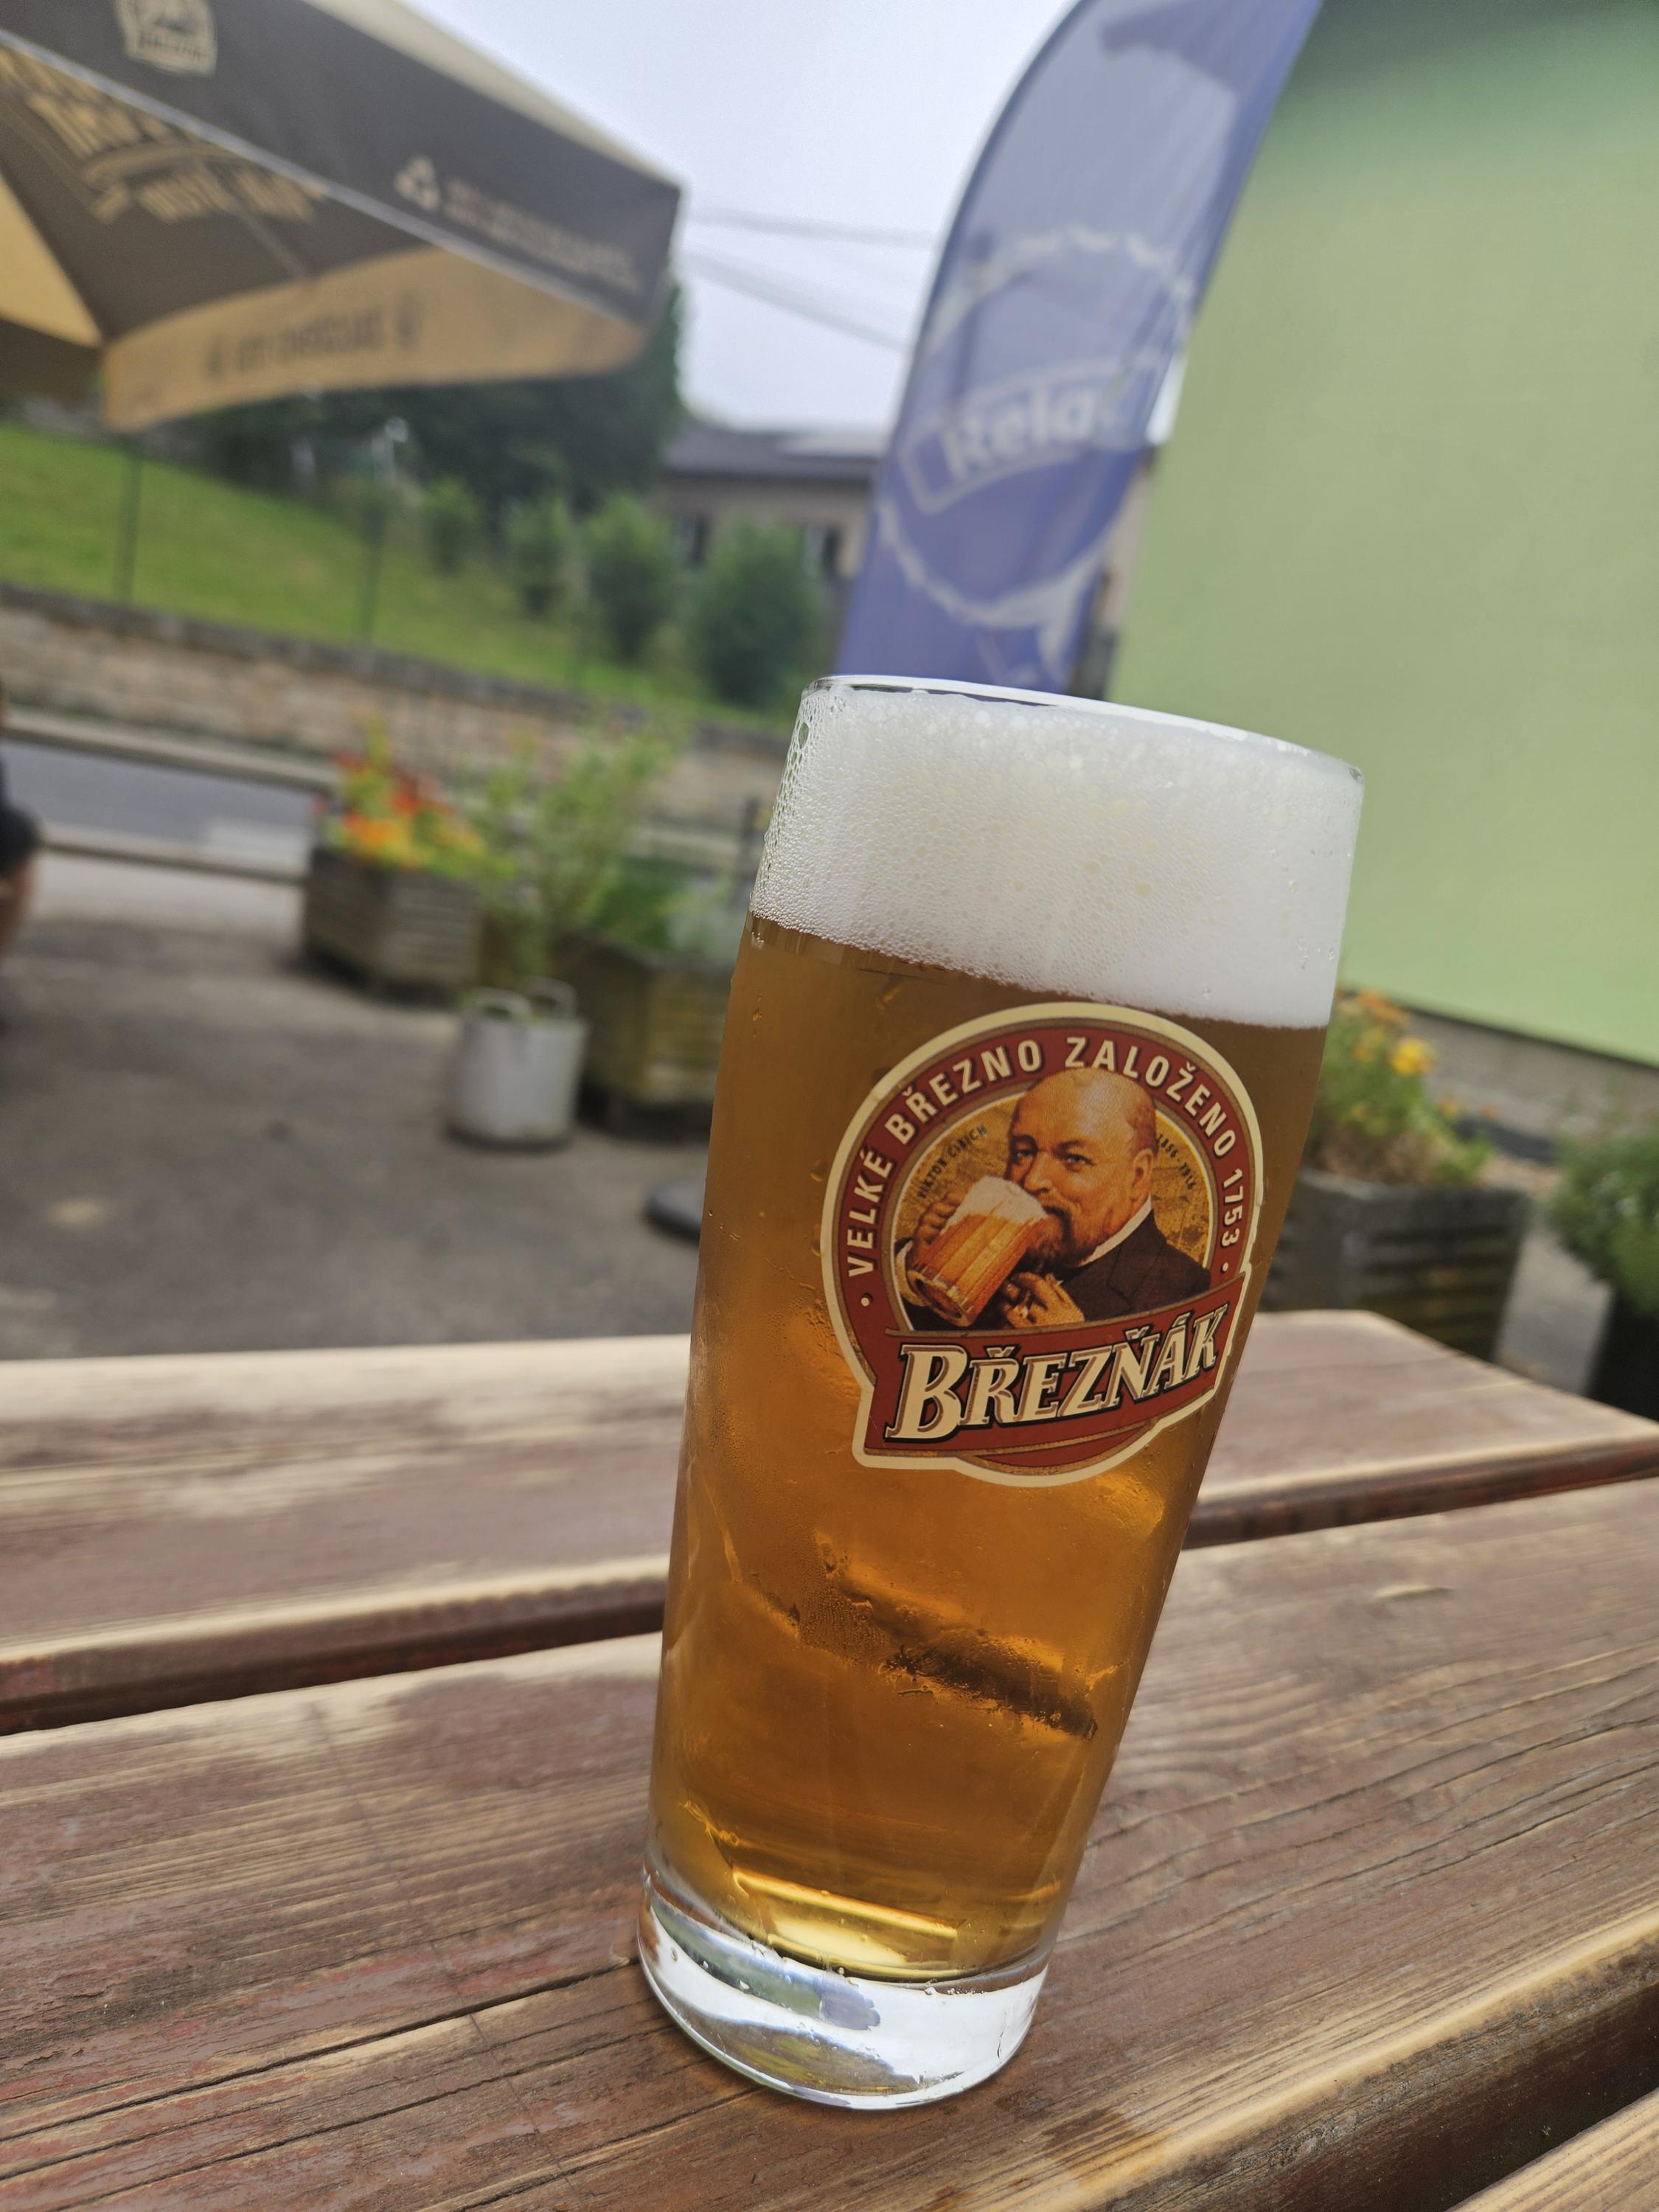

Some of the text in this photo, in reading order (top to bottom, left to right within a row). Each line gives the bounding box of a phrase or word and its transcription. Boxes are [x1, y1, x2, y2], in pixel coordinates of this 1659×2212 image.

[847, 1037, 1243, 1277] VELKÉ BŘEZNO ZALOŽENO 1753
[884, 1303, 1229, 1441] BŘEZŇÁK
